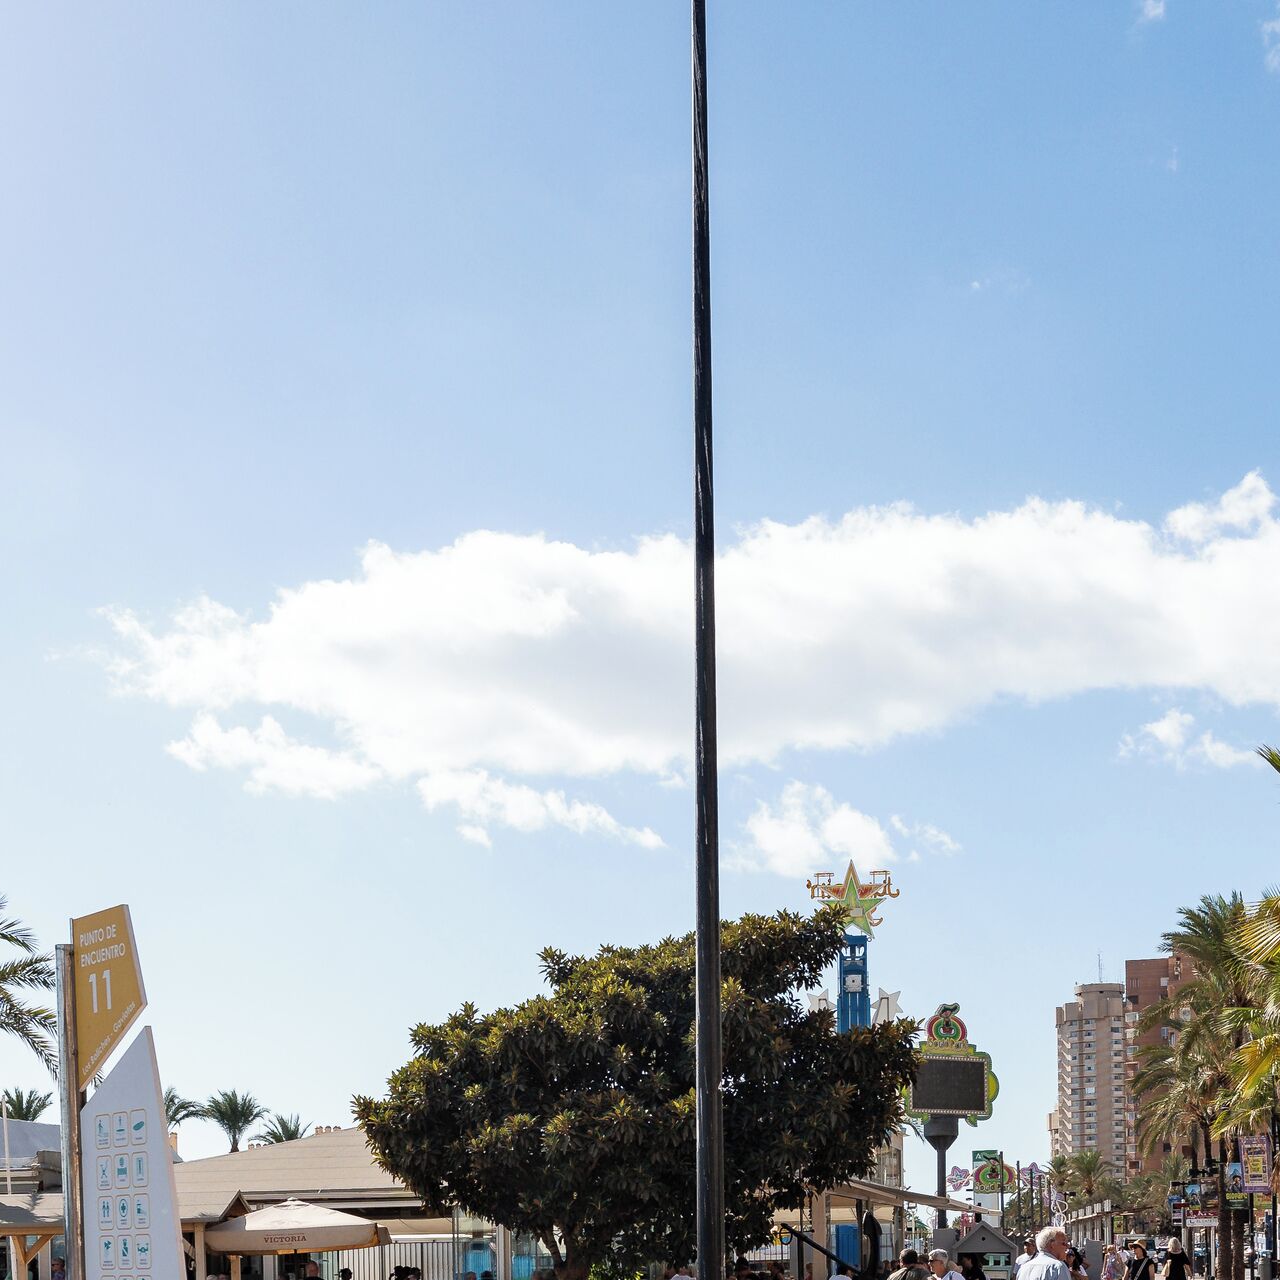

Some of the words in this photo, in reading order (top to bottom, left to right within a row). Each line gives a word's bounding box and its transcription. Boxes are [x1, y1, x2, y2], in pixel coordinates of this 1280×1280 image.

[79, 928, 104, 947] PUNTO
[106, 924, 117, 939] DE
[80, 942, 126, 968] ENCUENTRO
[88, 969, 112, 1014] 11
[264, 1235, 307, 1243] VICTORIA
